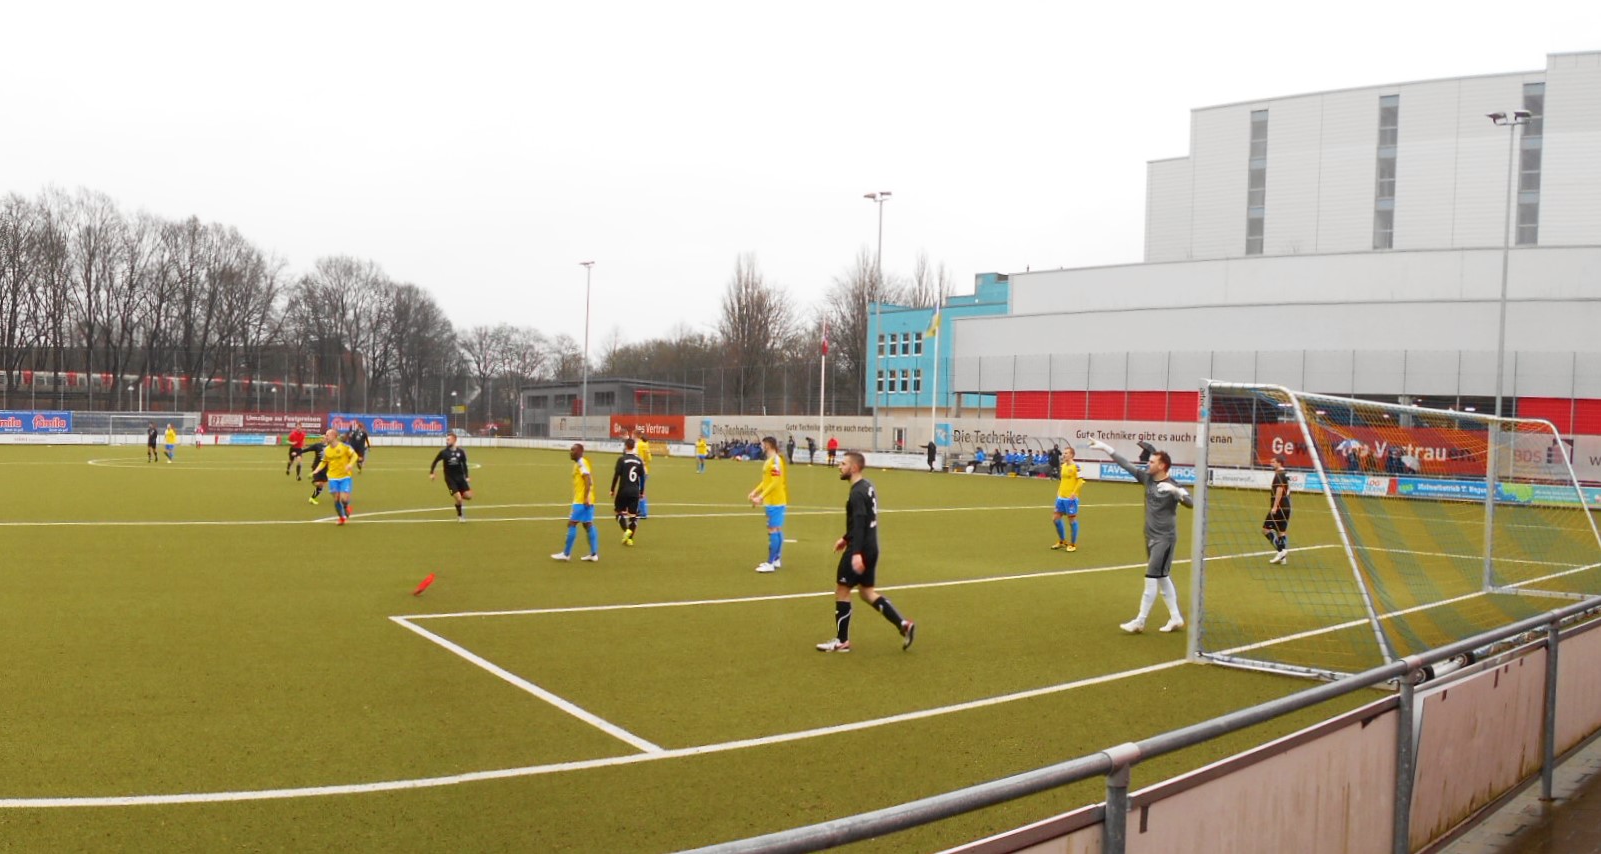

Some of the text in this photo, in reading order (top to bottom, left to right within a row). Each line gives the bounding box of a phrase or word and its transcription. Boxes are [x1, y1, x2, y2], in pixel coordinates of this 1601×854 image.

[953, 429, 1028, 445] Die Techniker
[1076, 430, 1095, 439] Gute
[1097, 430, 1136, 440] Techniker
[1138, 433, 1155, 443] gibt
[1169, 434, 1190, 443] auch
[1193, 435, 1233, 444] nenan
[629, 466, 637, 482] 6
